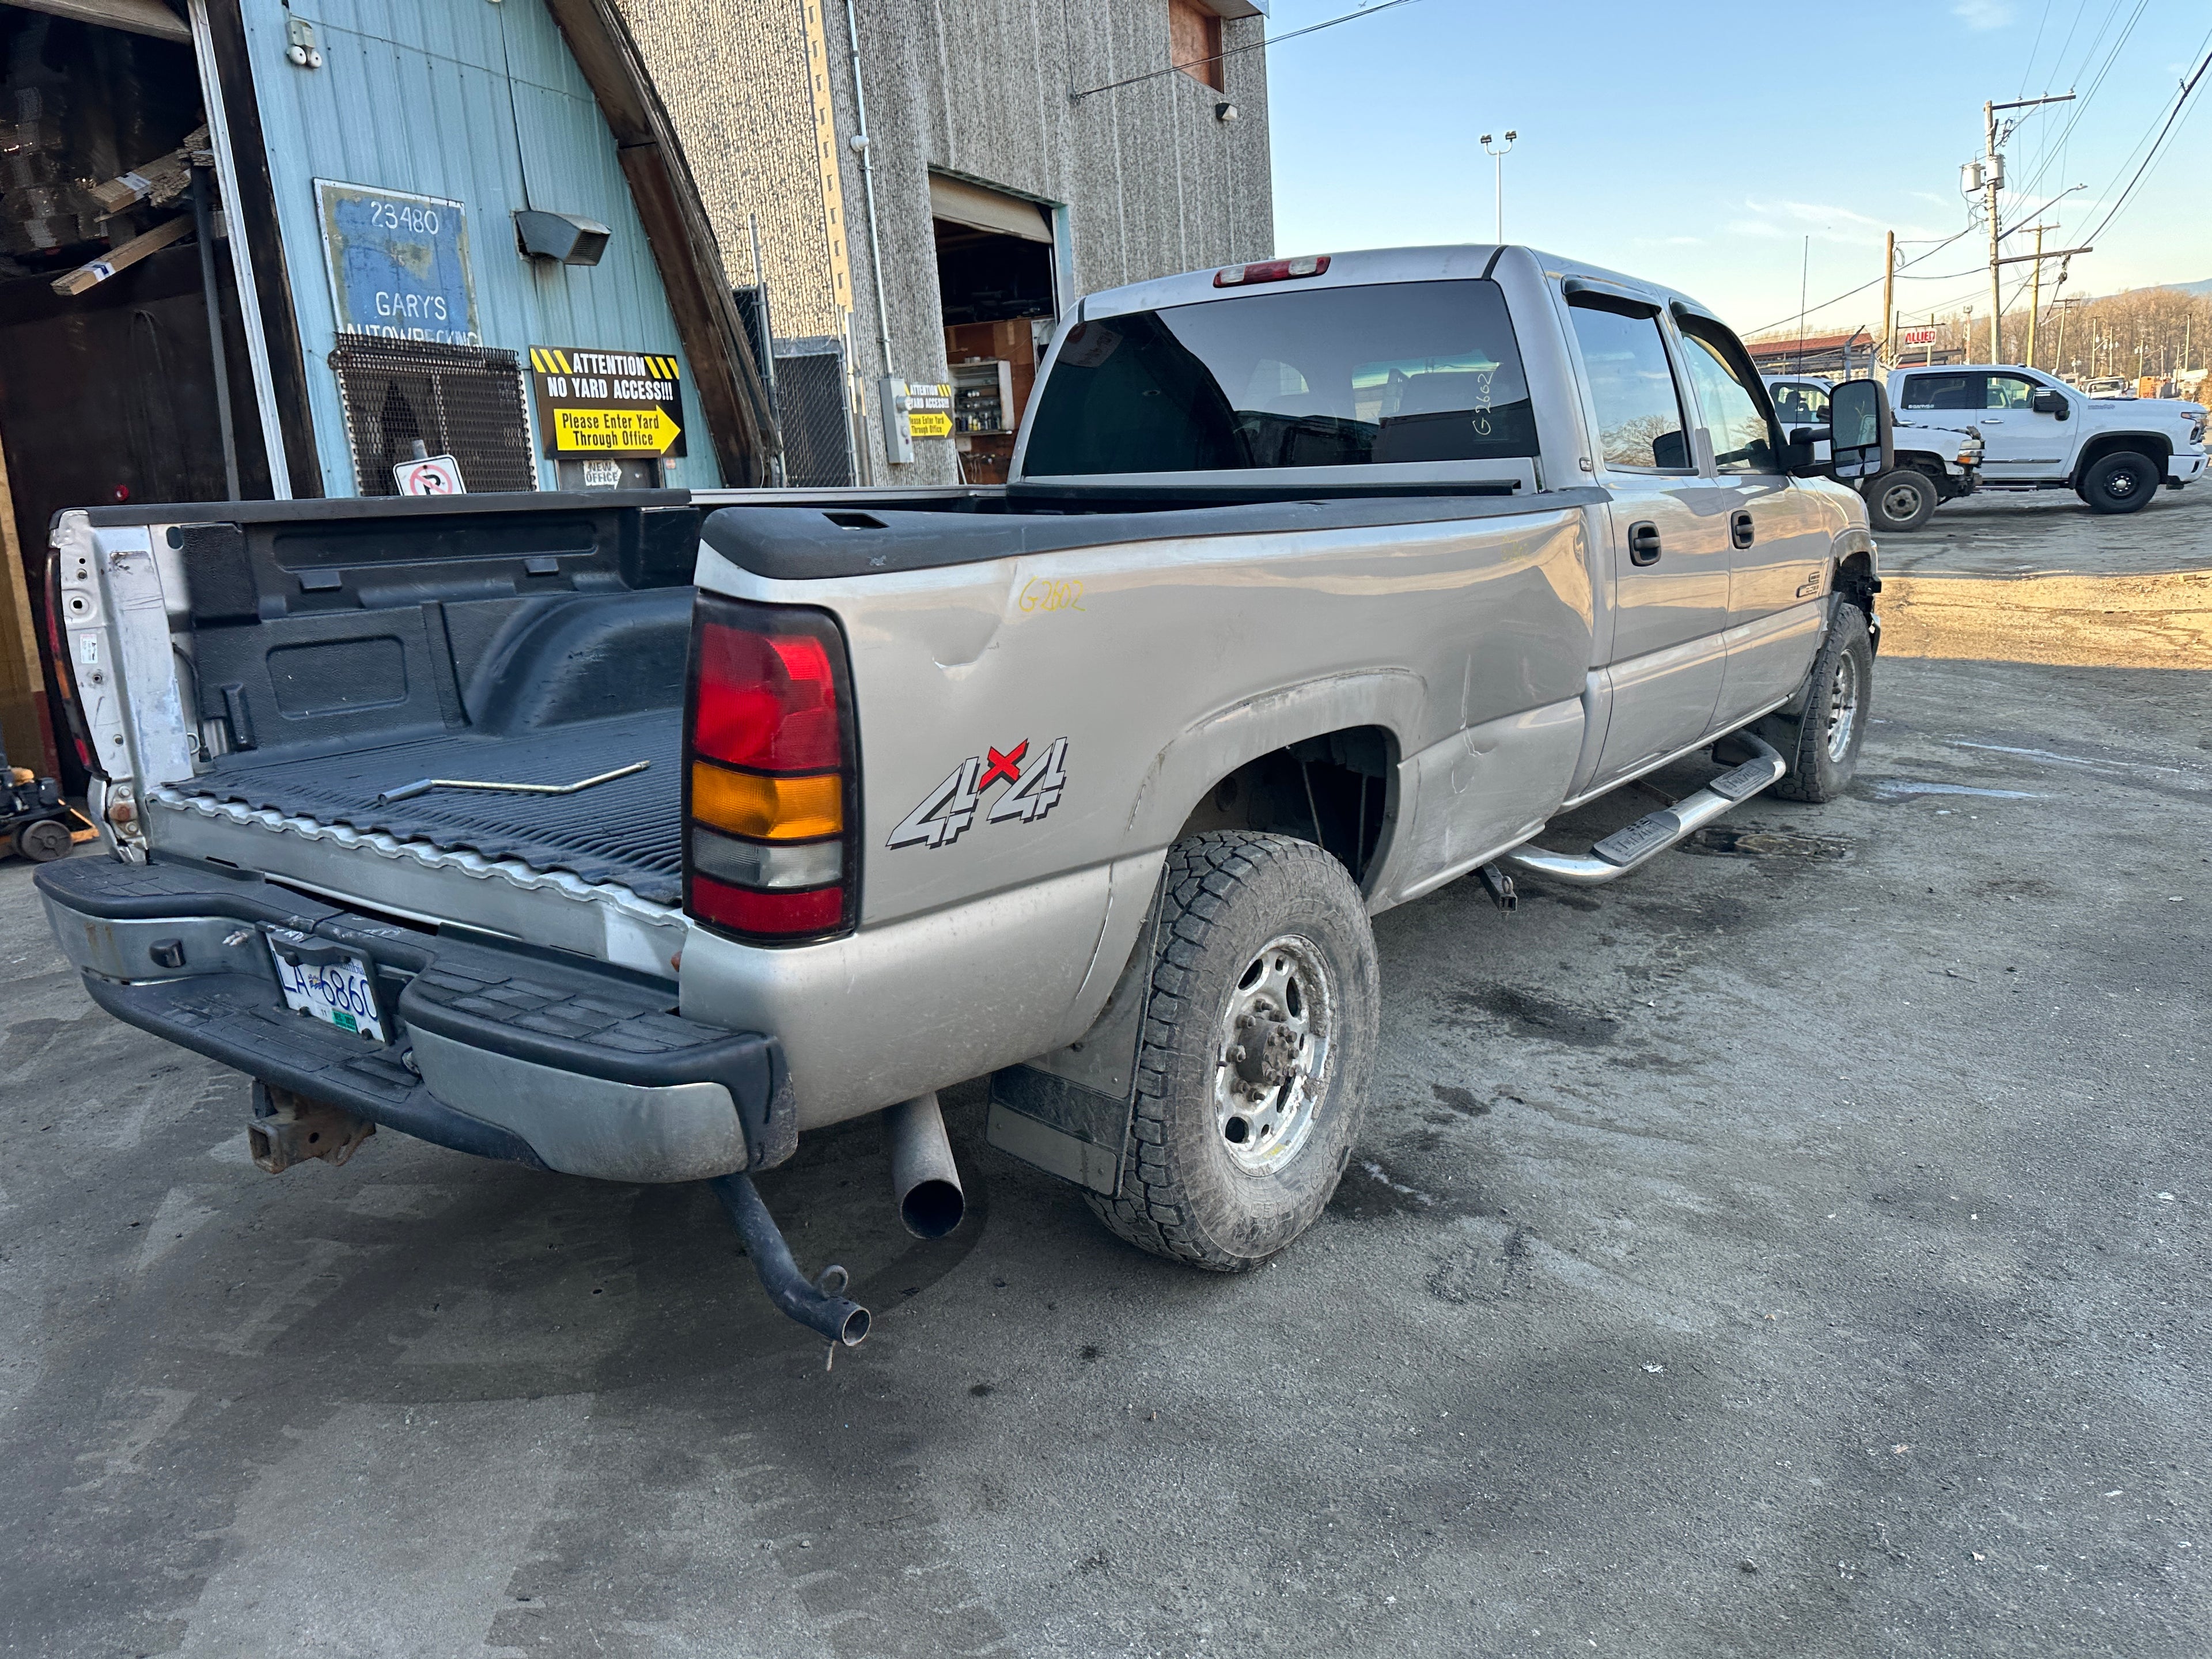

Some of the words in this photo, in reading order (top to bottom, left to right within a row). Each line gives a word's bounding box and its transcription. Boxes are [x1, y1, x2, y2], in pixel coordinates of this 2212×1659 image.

[371, 201, 439, 234] 23480
[376, 291, 447, 320] GARY'S
[1905, 331, 1935, 343] ALLIED
[573, 353, 646, 376] ATTENTION
[547, 377, 567, 397] NO
[571, 378, 608, 399] YARD
[613, 380, 673, 400] ACCESS!!!
[910, 384, 938, 396] ATTENTION
[910, 397, 924, 408] ARD
[562, 413, 599, 429] Please
[604, 414, 632, 429] Enter
[636, 414, 660, 429] Yard
[909, 416, 921, 425] lease
[573, 430, 618, 448] Through
[622, 431, 653, 445] Office
[588, 461, 611, 472] NEW
[586, 472, 618, 483] OFFICE
